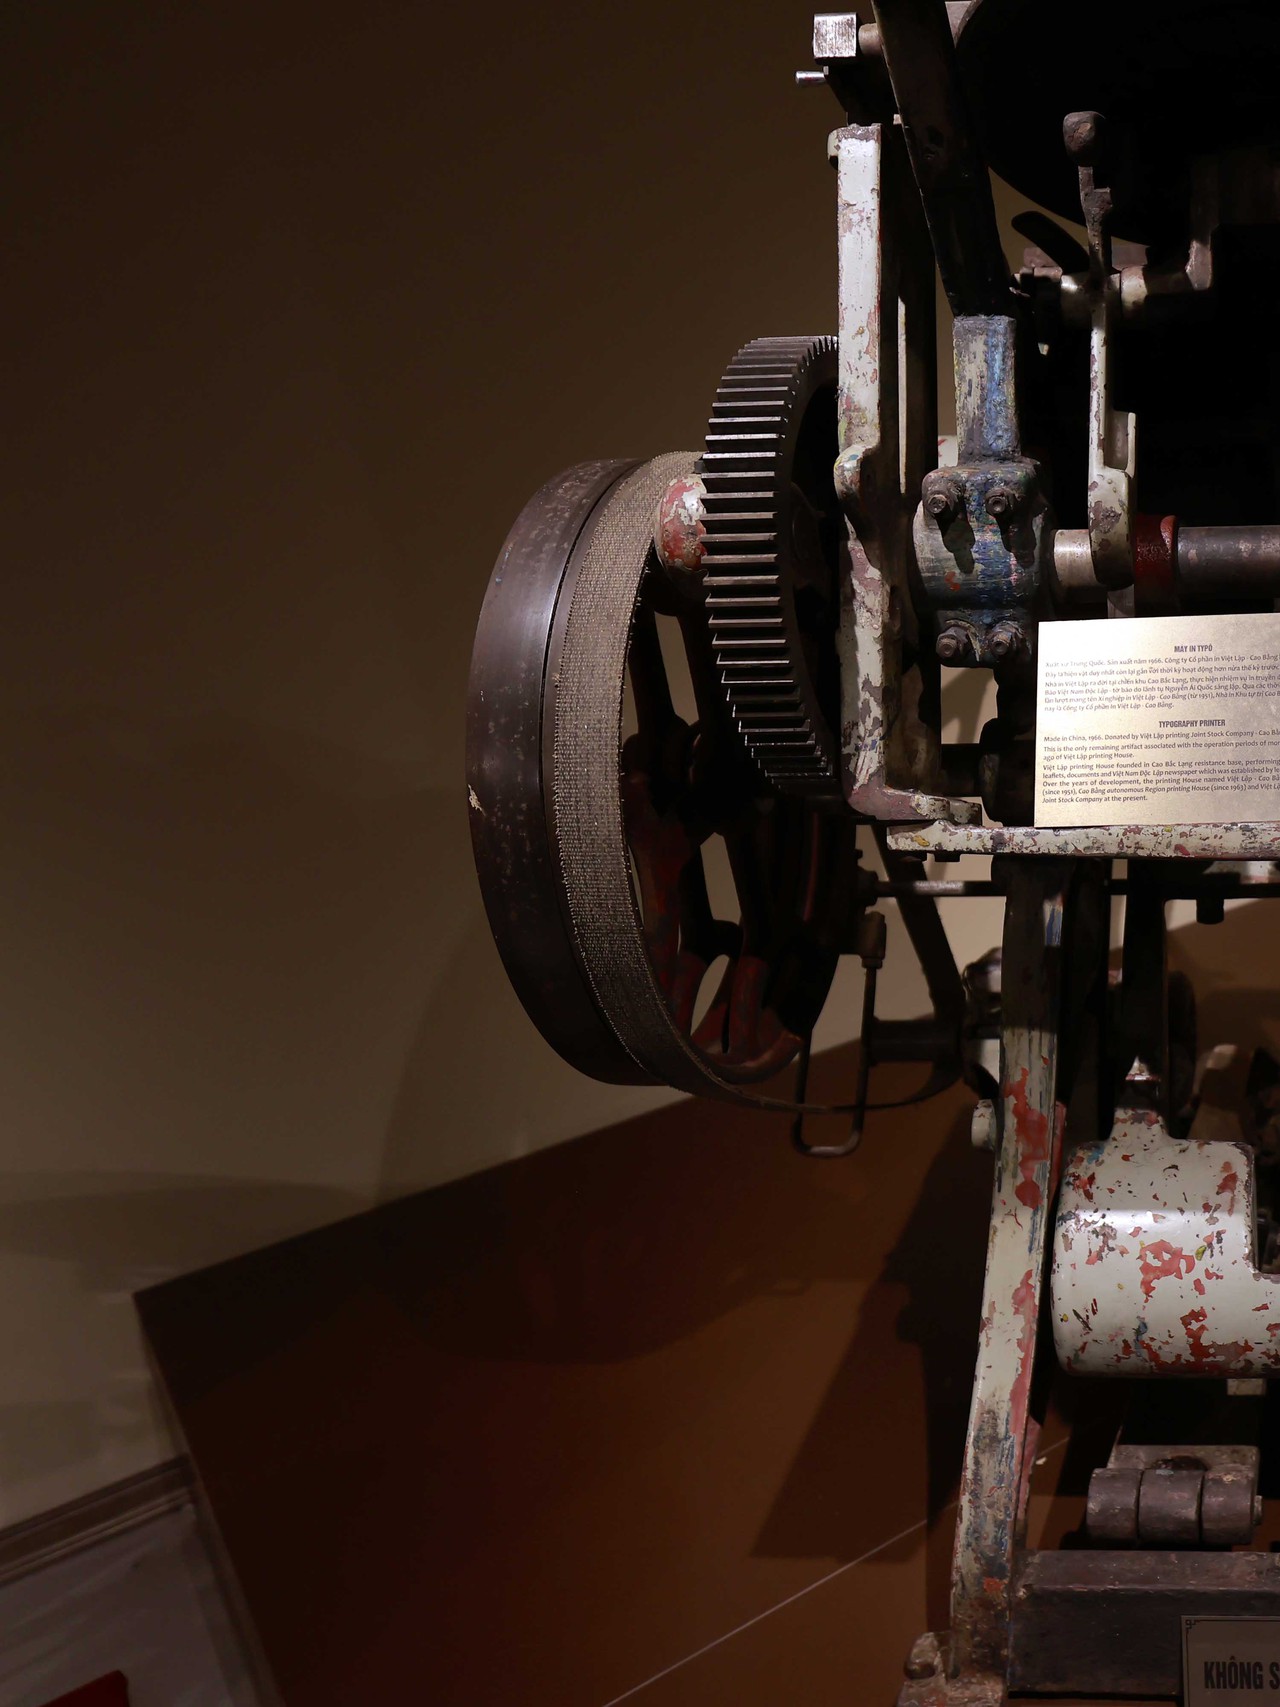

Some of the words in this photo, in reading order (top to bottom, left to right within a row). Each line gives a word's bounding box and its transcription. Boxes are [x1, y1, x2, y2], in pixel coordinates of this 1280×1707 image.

[1159, 720, 1198, 728] TYPOGRAPHY
[1199, 719, 1225, 727] PRINTER
[1165, 732, 1190, 740] printing
[1225, 730, 1254, 738] Company
[1145, 786, 1166, 794] Region
[1230, 784, 1247, 792] 1963)
[1075, 796, 1103, 804] Company
[1204, 1655, 1263, 1689] KHÔNG
